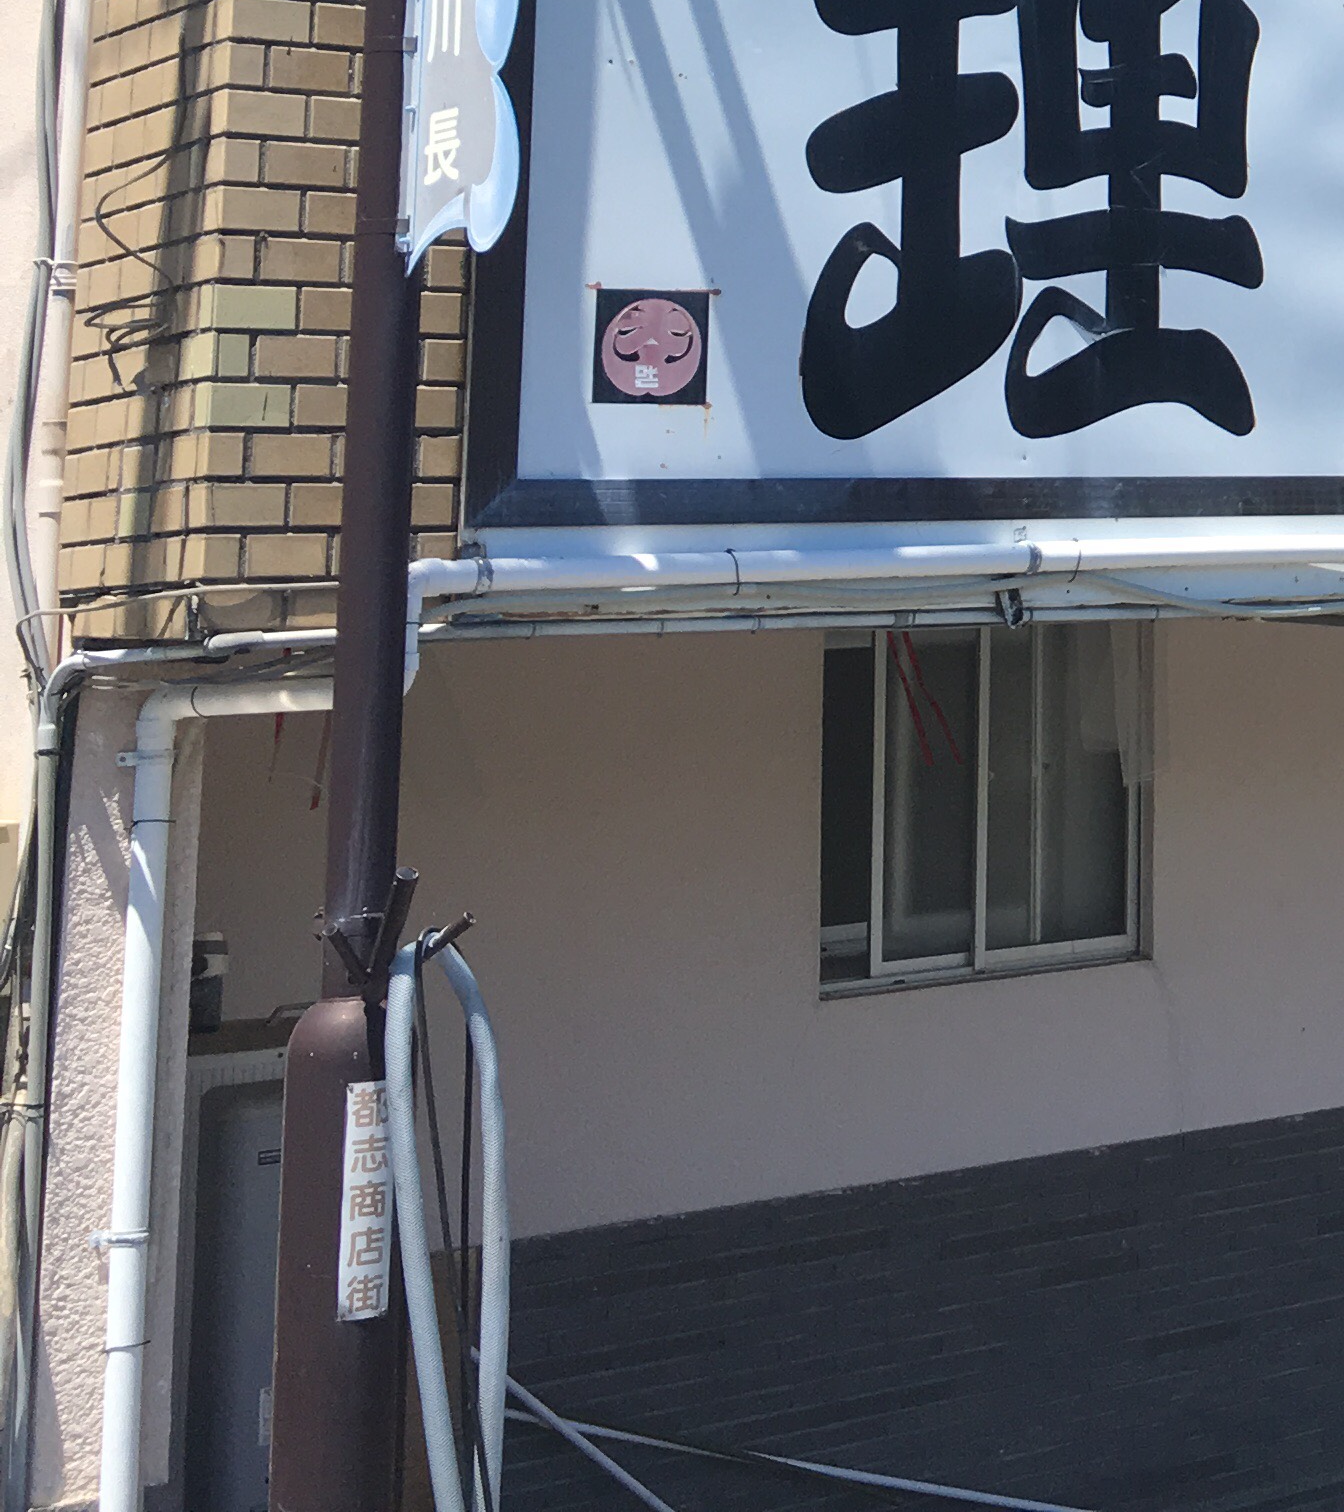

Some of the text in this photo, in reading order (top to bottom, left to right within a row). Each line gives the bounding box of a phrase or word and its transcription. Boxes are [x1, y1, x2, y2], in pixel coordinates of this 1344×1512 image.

[345, 1087, 389, 1314] 都志商店街
